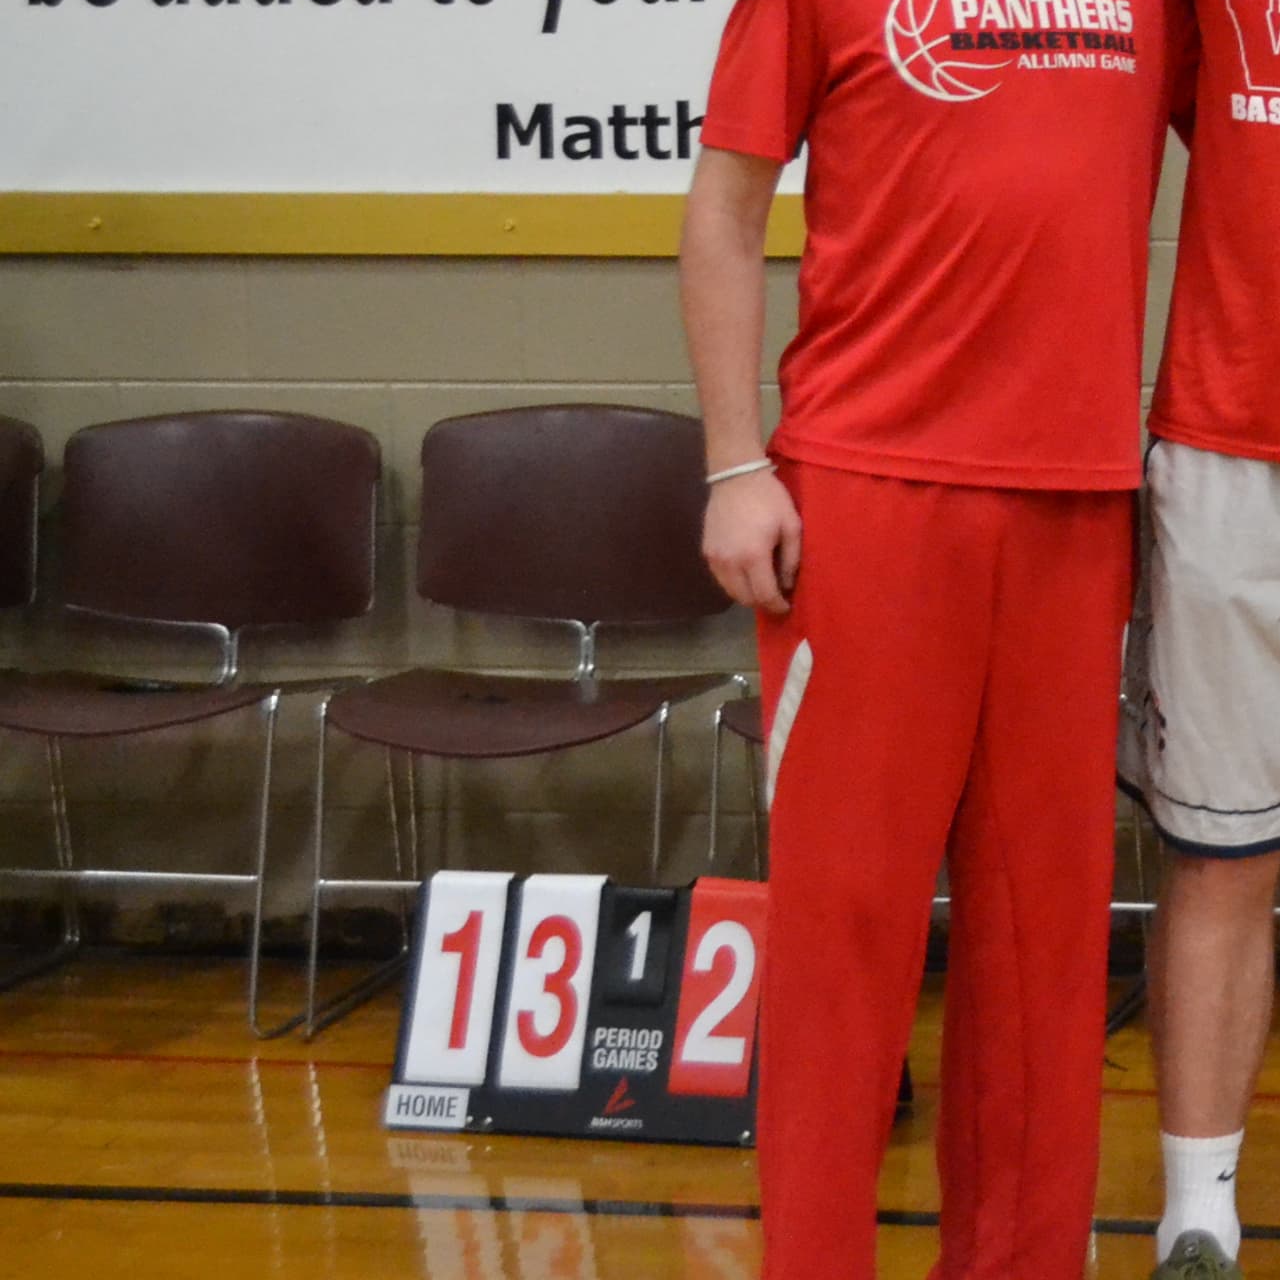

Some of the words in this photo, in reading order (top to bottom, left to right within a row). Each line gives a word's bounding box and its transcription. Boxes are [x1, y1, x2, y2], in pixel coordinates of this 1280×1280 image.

[950, 32, 1137, 55] BASKETBALL
[1017, 53, 1097, 70] ALUMNI
[1100, 54, 1137, 74] GAME
[496, 100, 706, 160] Matth
[627, 910, 653, 981] 1
[680, 919, 757, 1065] 2
[593, 1027, 664, 1050] PERIOD
[593, 1049, 659, 1072] GAMES
[396, 1093, 460, 1119] HOME
